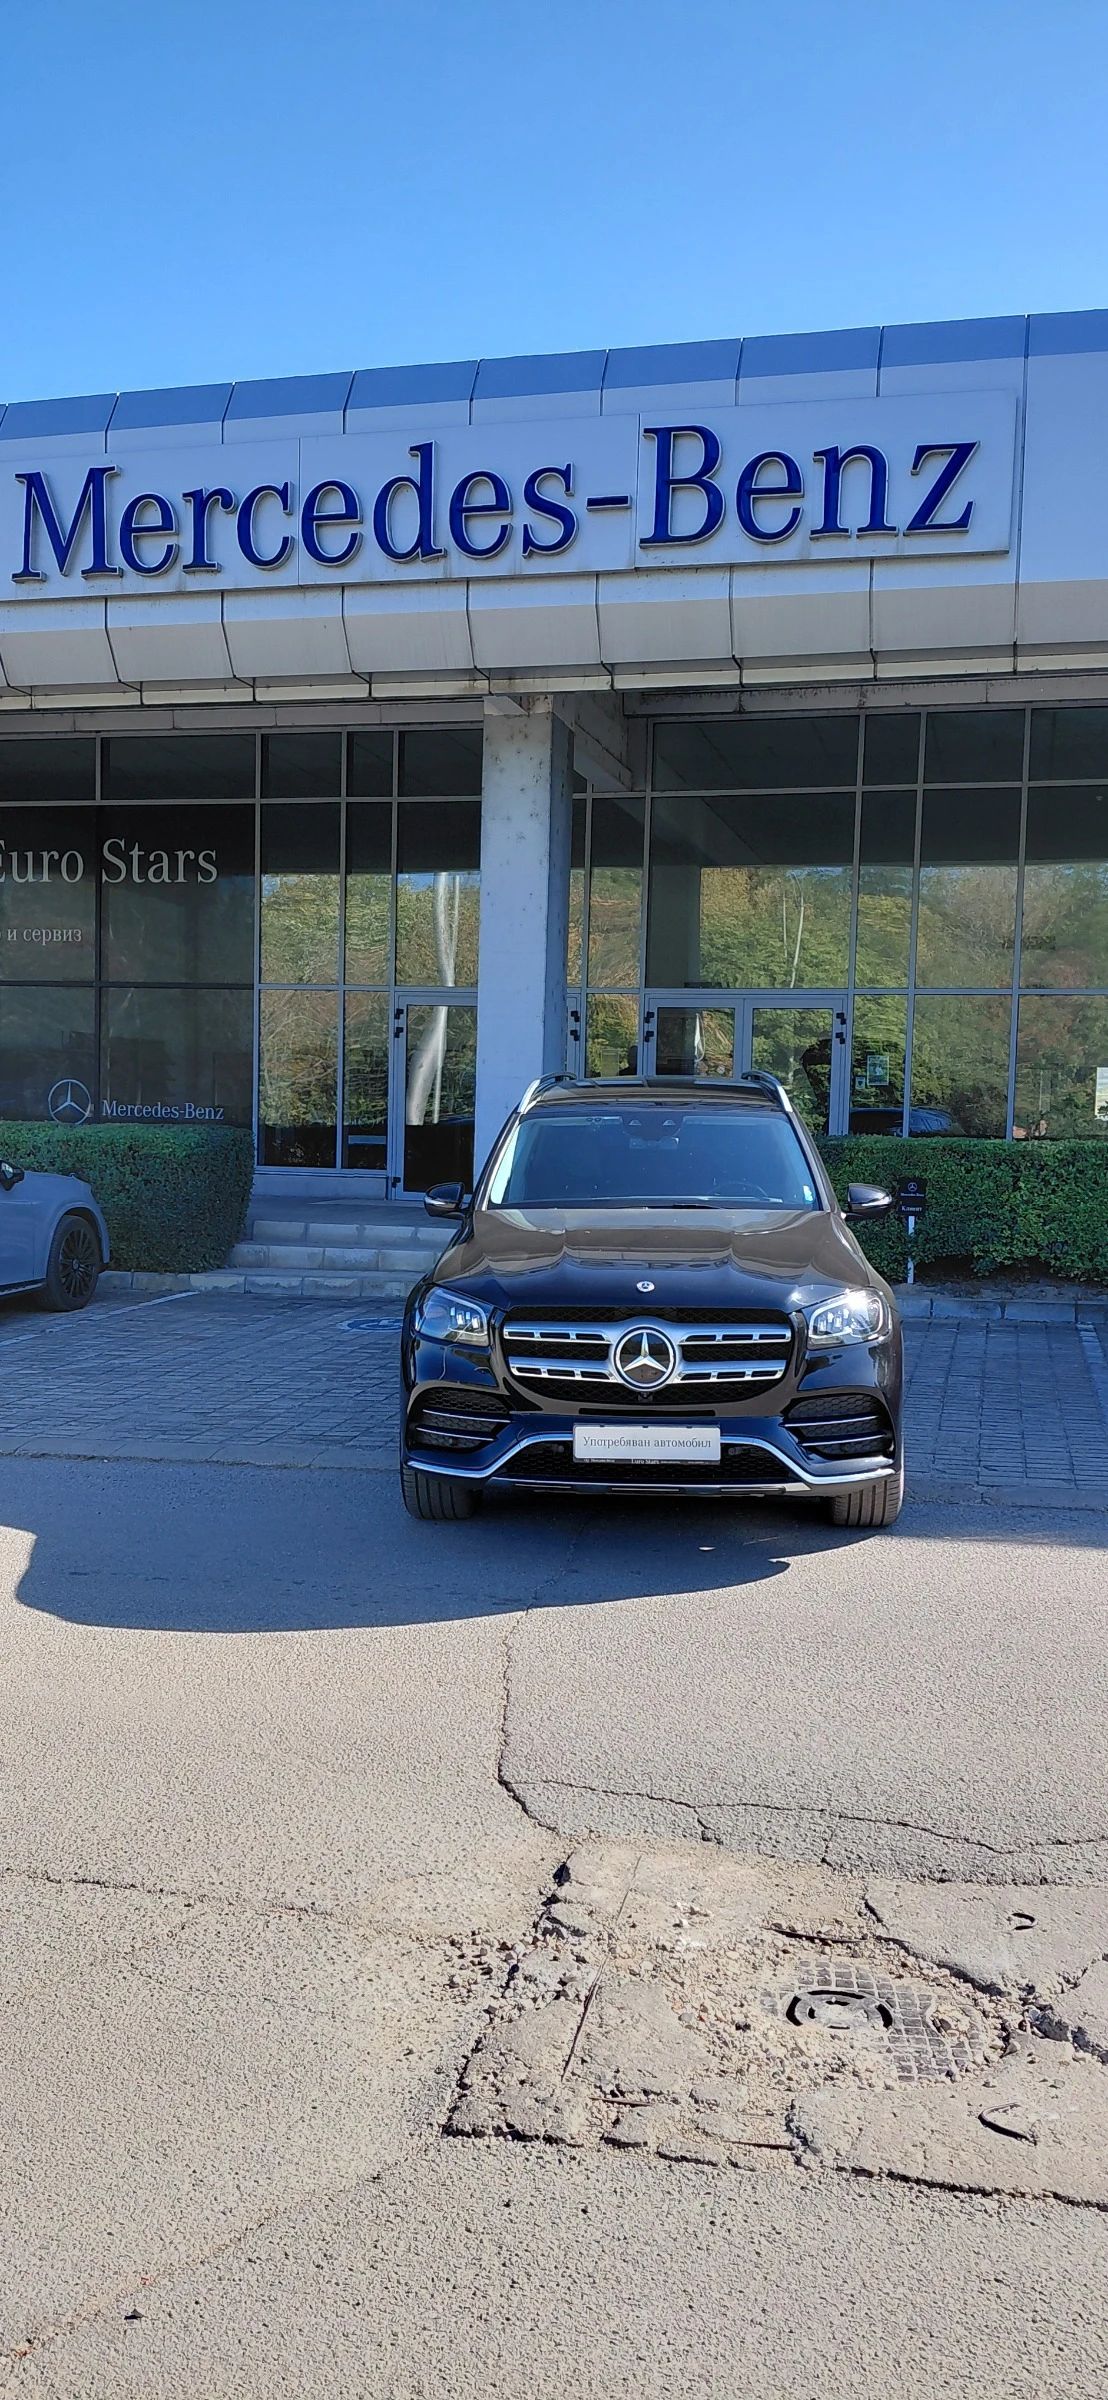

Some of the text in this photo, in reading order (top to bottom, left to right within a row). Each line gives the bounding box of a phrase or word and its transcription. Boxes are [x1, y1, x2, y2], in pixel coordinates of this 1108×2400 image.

[11, 425, 981, 583] Mercedes-Benz
[0, 838, 218, 884] uro Stars
[7, 928, 17, 941] и
[23, 928, 82, 946] сервиз
[102, 1100, 224, 1120] Mercedes-Benz
[583, 1436, 711, 1448] Употребяван автомобил
